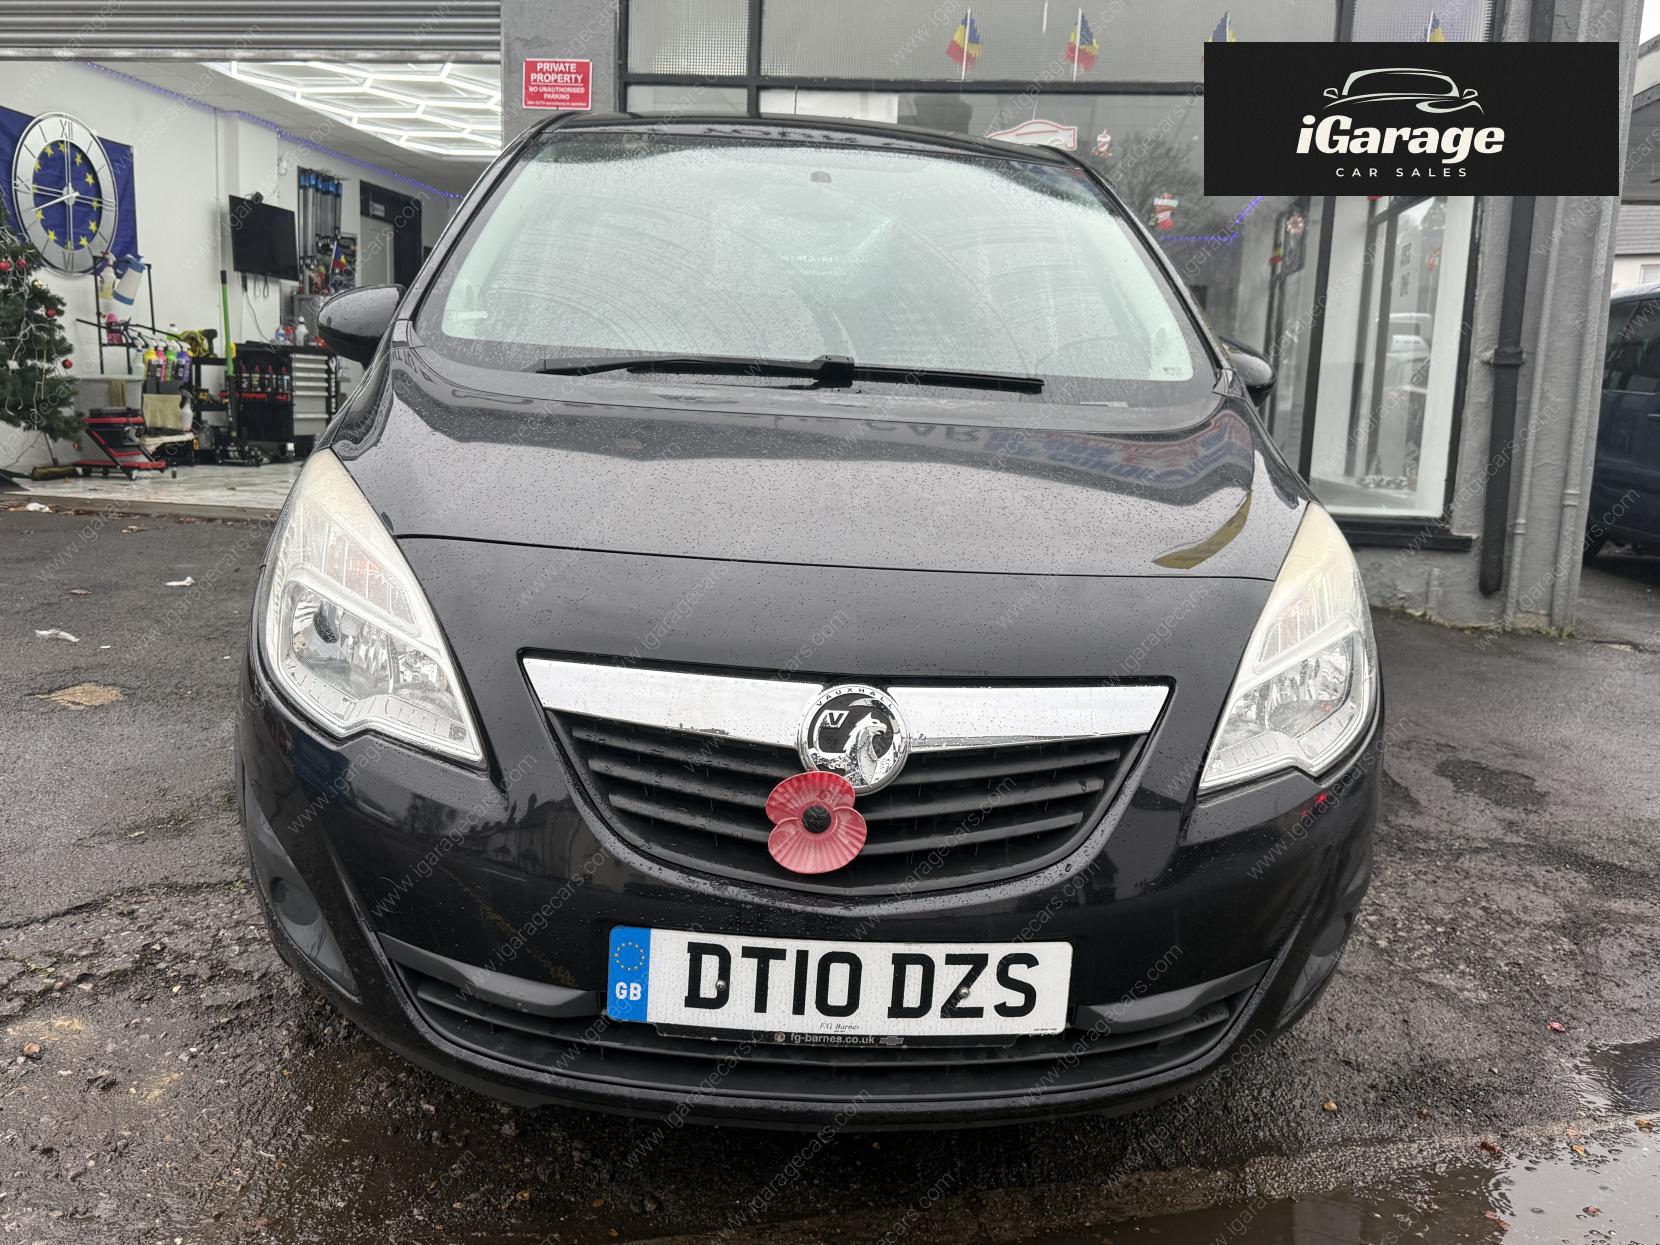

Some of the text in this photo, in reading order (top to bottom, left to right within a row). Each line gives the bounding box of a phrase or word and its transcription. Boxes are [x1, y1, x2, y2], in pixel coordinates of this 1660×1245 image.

[537, 62, 577, 72] PRIVATE
[530, 73, 583, 83] PROPERTY
[816, 688, 893, 710] VAUXHALL
[684, 941, 1040, 1019] DT10 DZS
[615, 982, 643, 1001] GB
[790, 1033, 875, 1044] fg-barnes.co.uk
